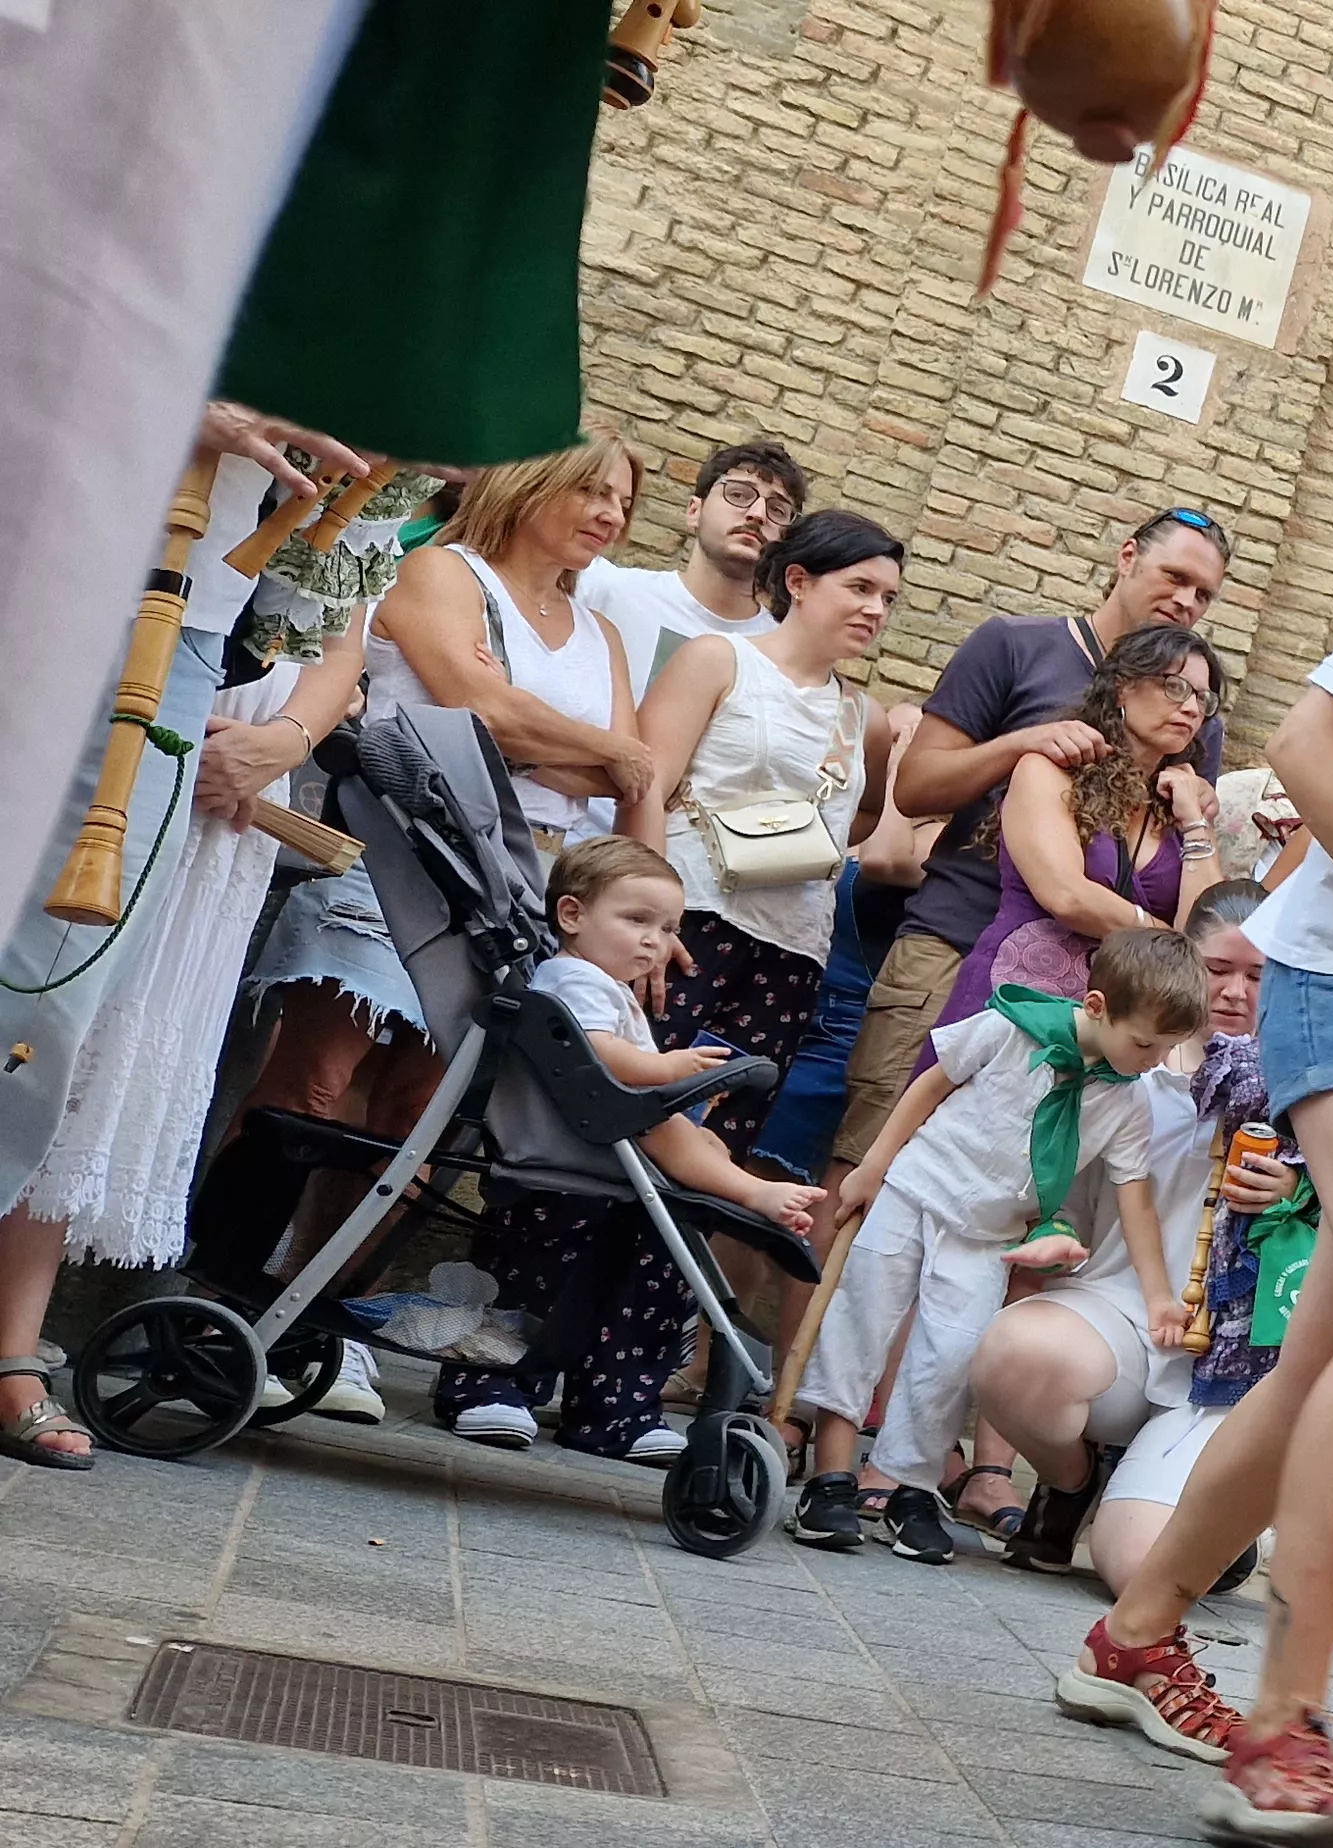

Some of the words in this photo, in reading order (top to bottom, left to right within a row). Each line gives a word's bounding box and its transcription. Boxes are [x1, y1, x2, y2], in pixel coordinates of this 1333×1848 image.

[1130, 184, 1143, 210] Y
[1147, 192, 1277, 262] PARROQUIAL
[1233, 188, 1285, 229] REAL
[1179, 239, 1211, 271] DE
[1150, 354, 1184, 398] 2
